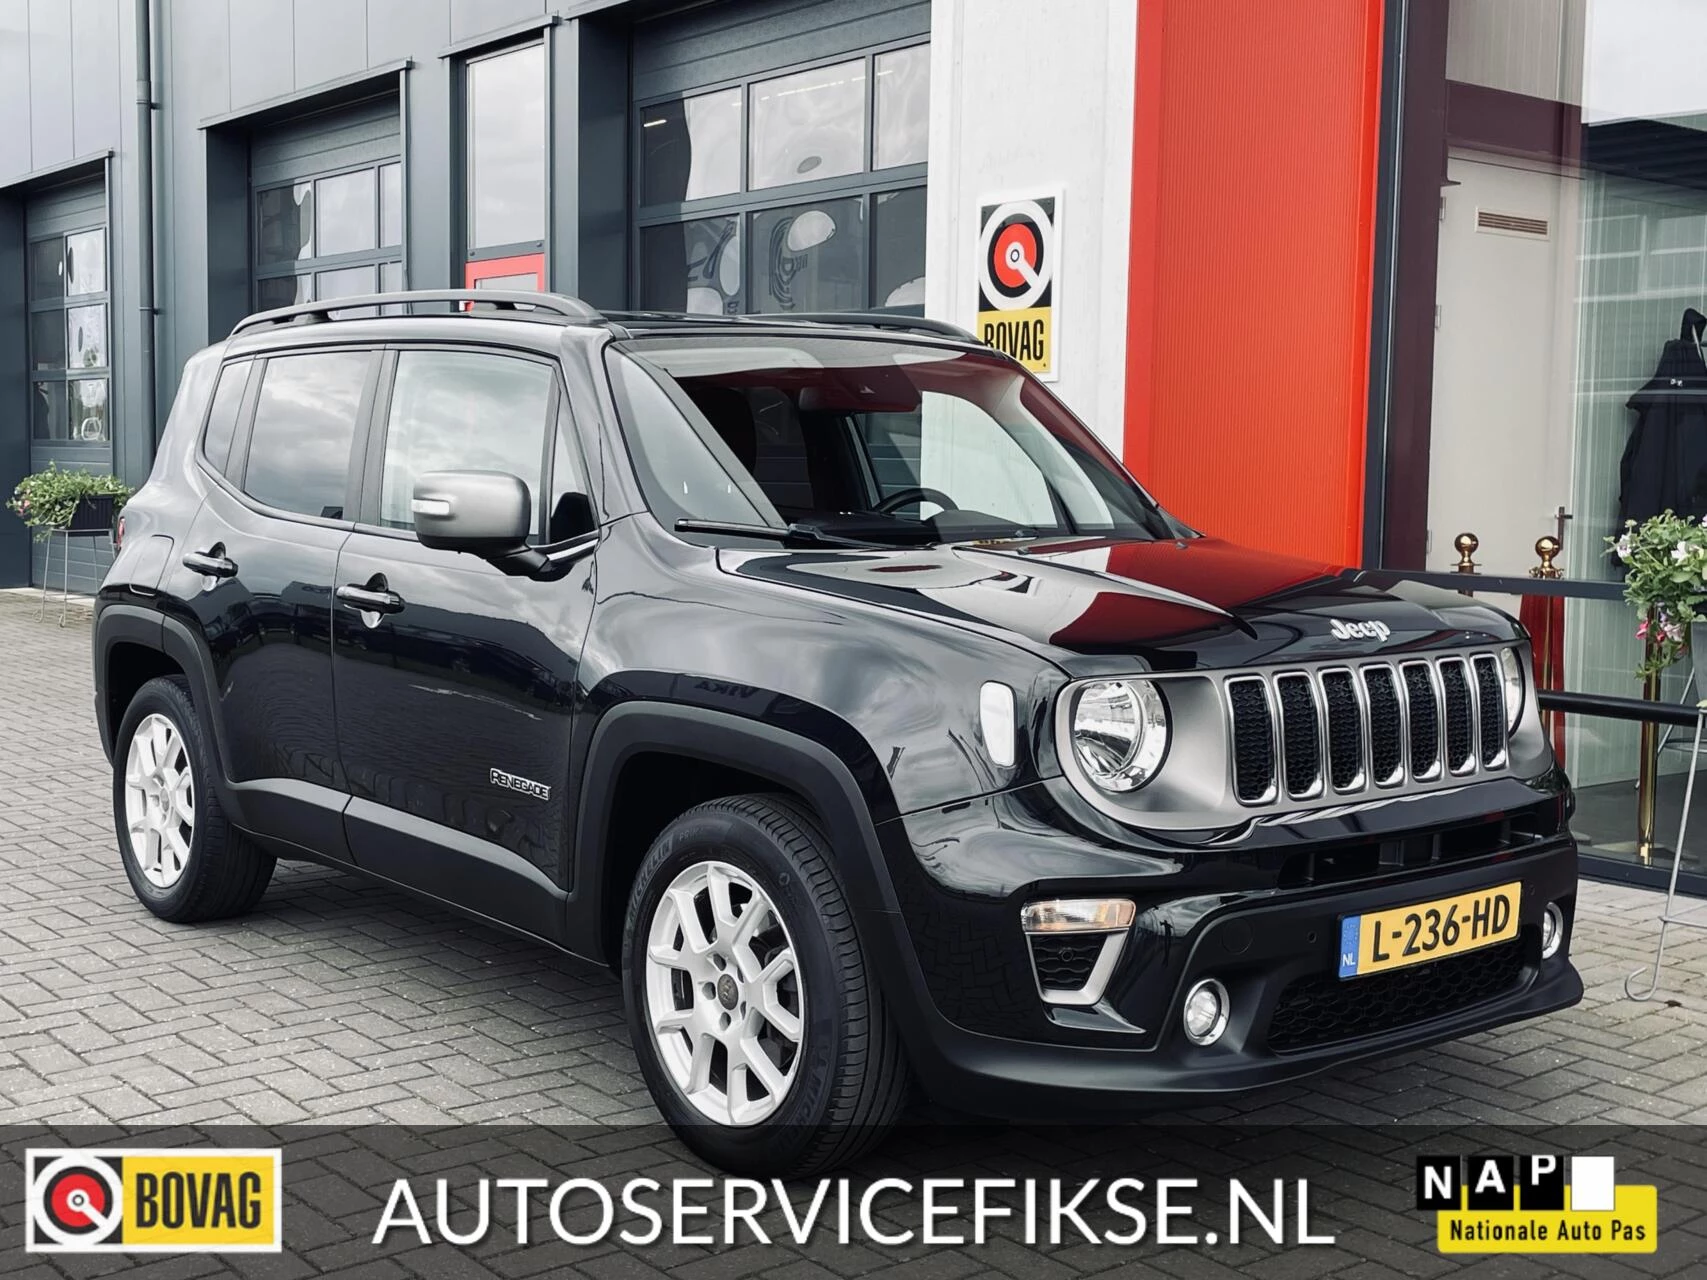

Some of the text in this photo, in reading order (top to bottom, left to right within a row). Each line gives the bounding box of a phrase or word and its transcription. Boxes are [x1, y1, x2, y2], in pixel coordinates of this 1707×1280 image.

[984, 319, 1044, 361] BOVAG
[1329, 619, 1391, 642] Jeep
[490, 768, 551, 801] RENEGADE
[1373, 894, 1511, 963] L-236-HD
[1342, 952, 1356, 967] NL
